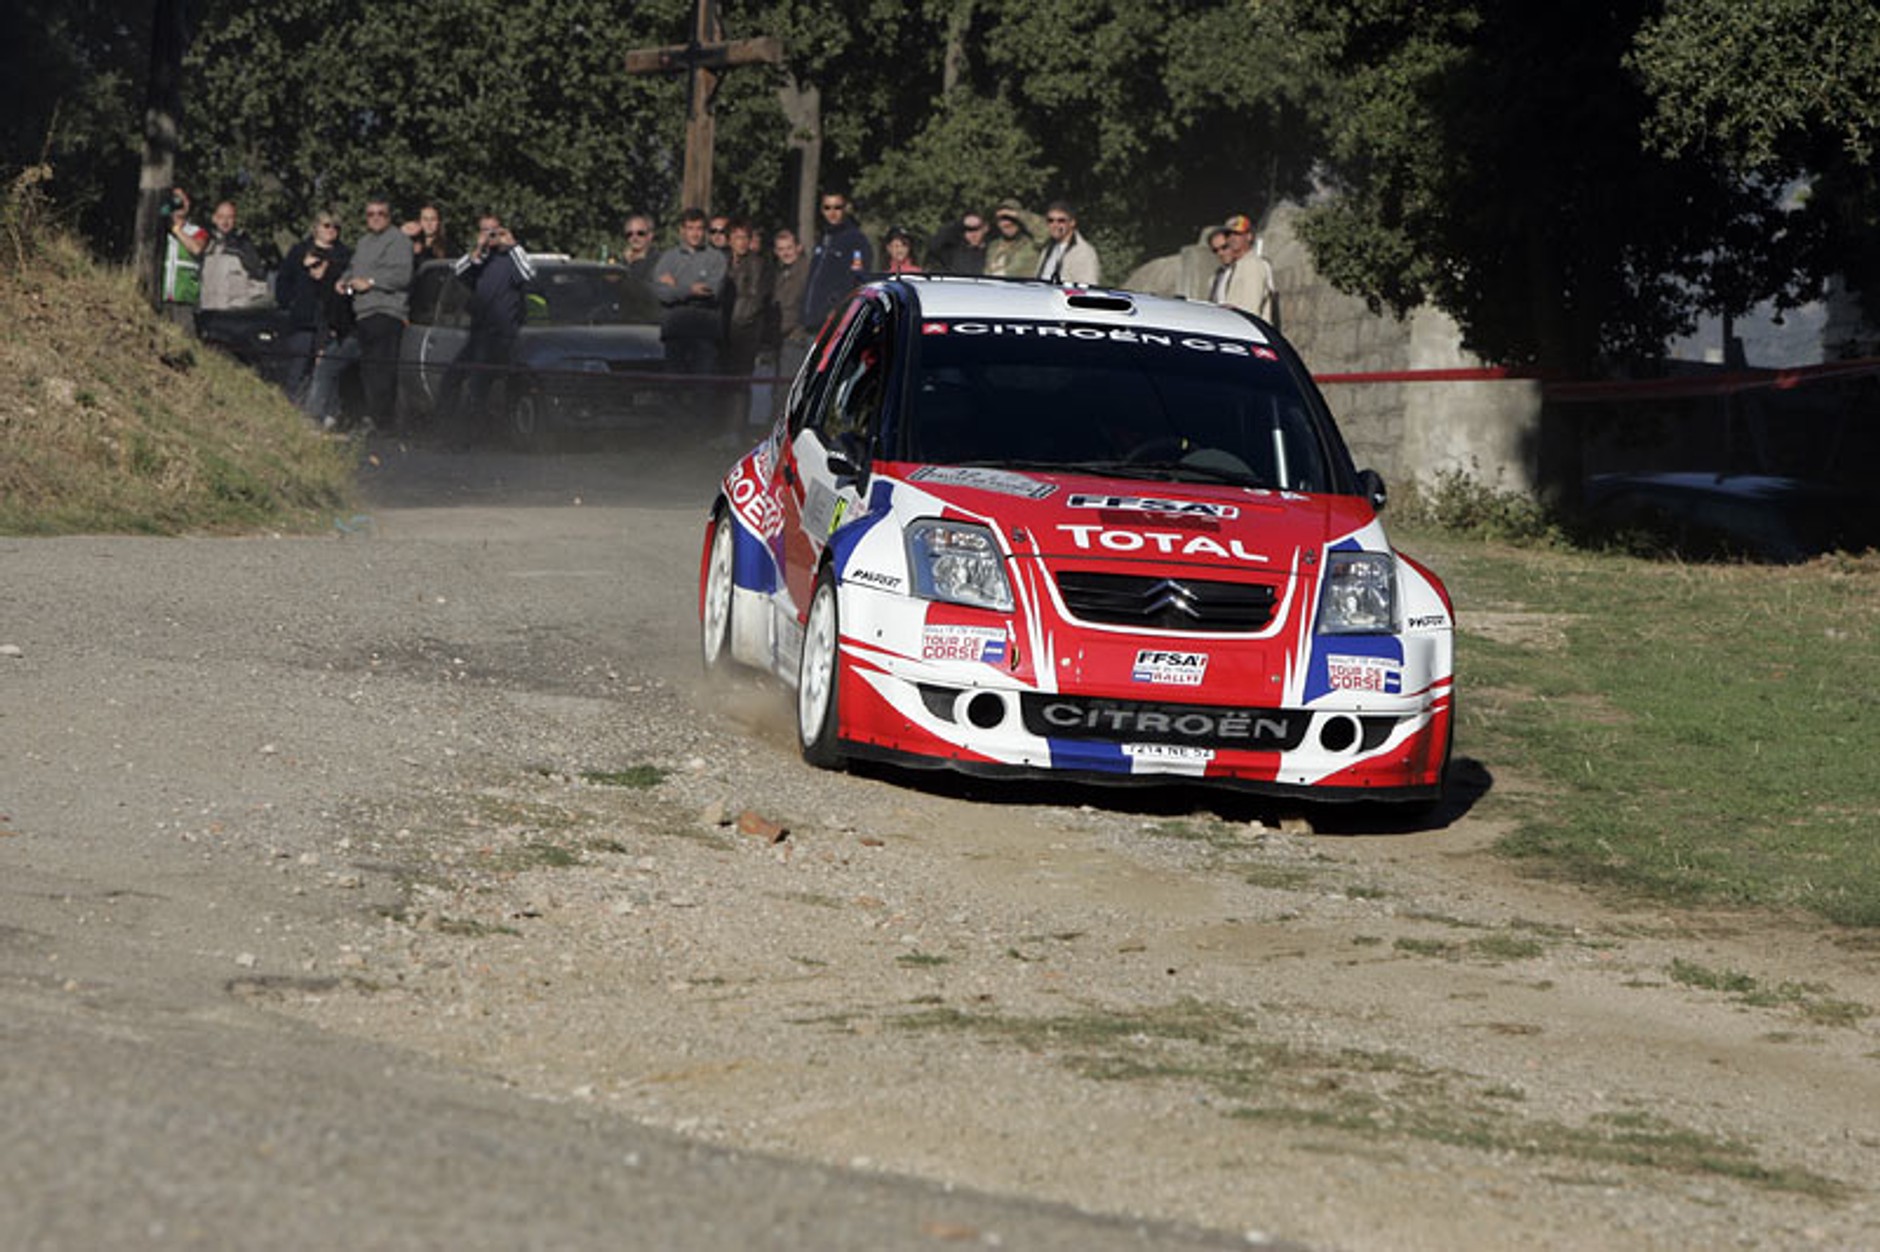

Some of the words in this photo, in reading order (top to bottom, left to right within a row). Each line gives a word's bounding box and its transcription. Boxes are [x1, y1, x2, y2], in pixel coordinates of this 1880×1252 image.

[953, 322, 1172, 346] CITROËN
[1181, 339, 1250, 358] C2
[1056, 524, 1270, 563] TOTAL
[924, 635, 960, 646] TOUR
[963, 636, 982, 648] DE
[923, 645, 980, 661] CORSE
[1138, 650, 1198, 667] FFSA
[1330, 674, 1383, 692] CORSE
[1042, 702, 1288, 740] CITROËN
